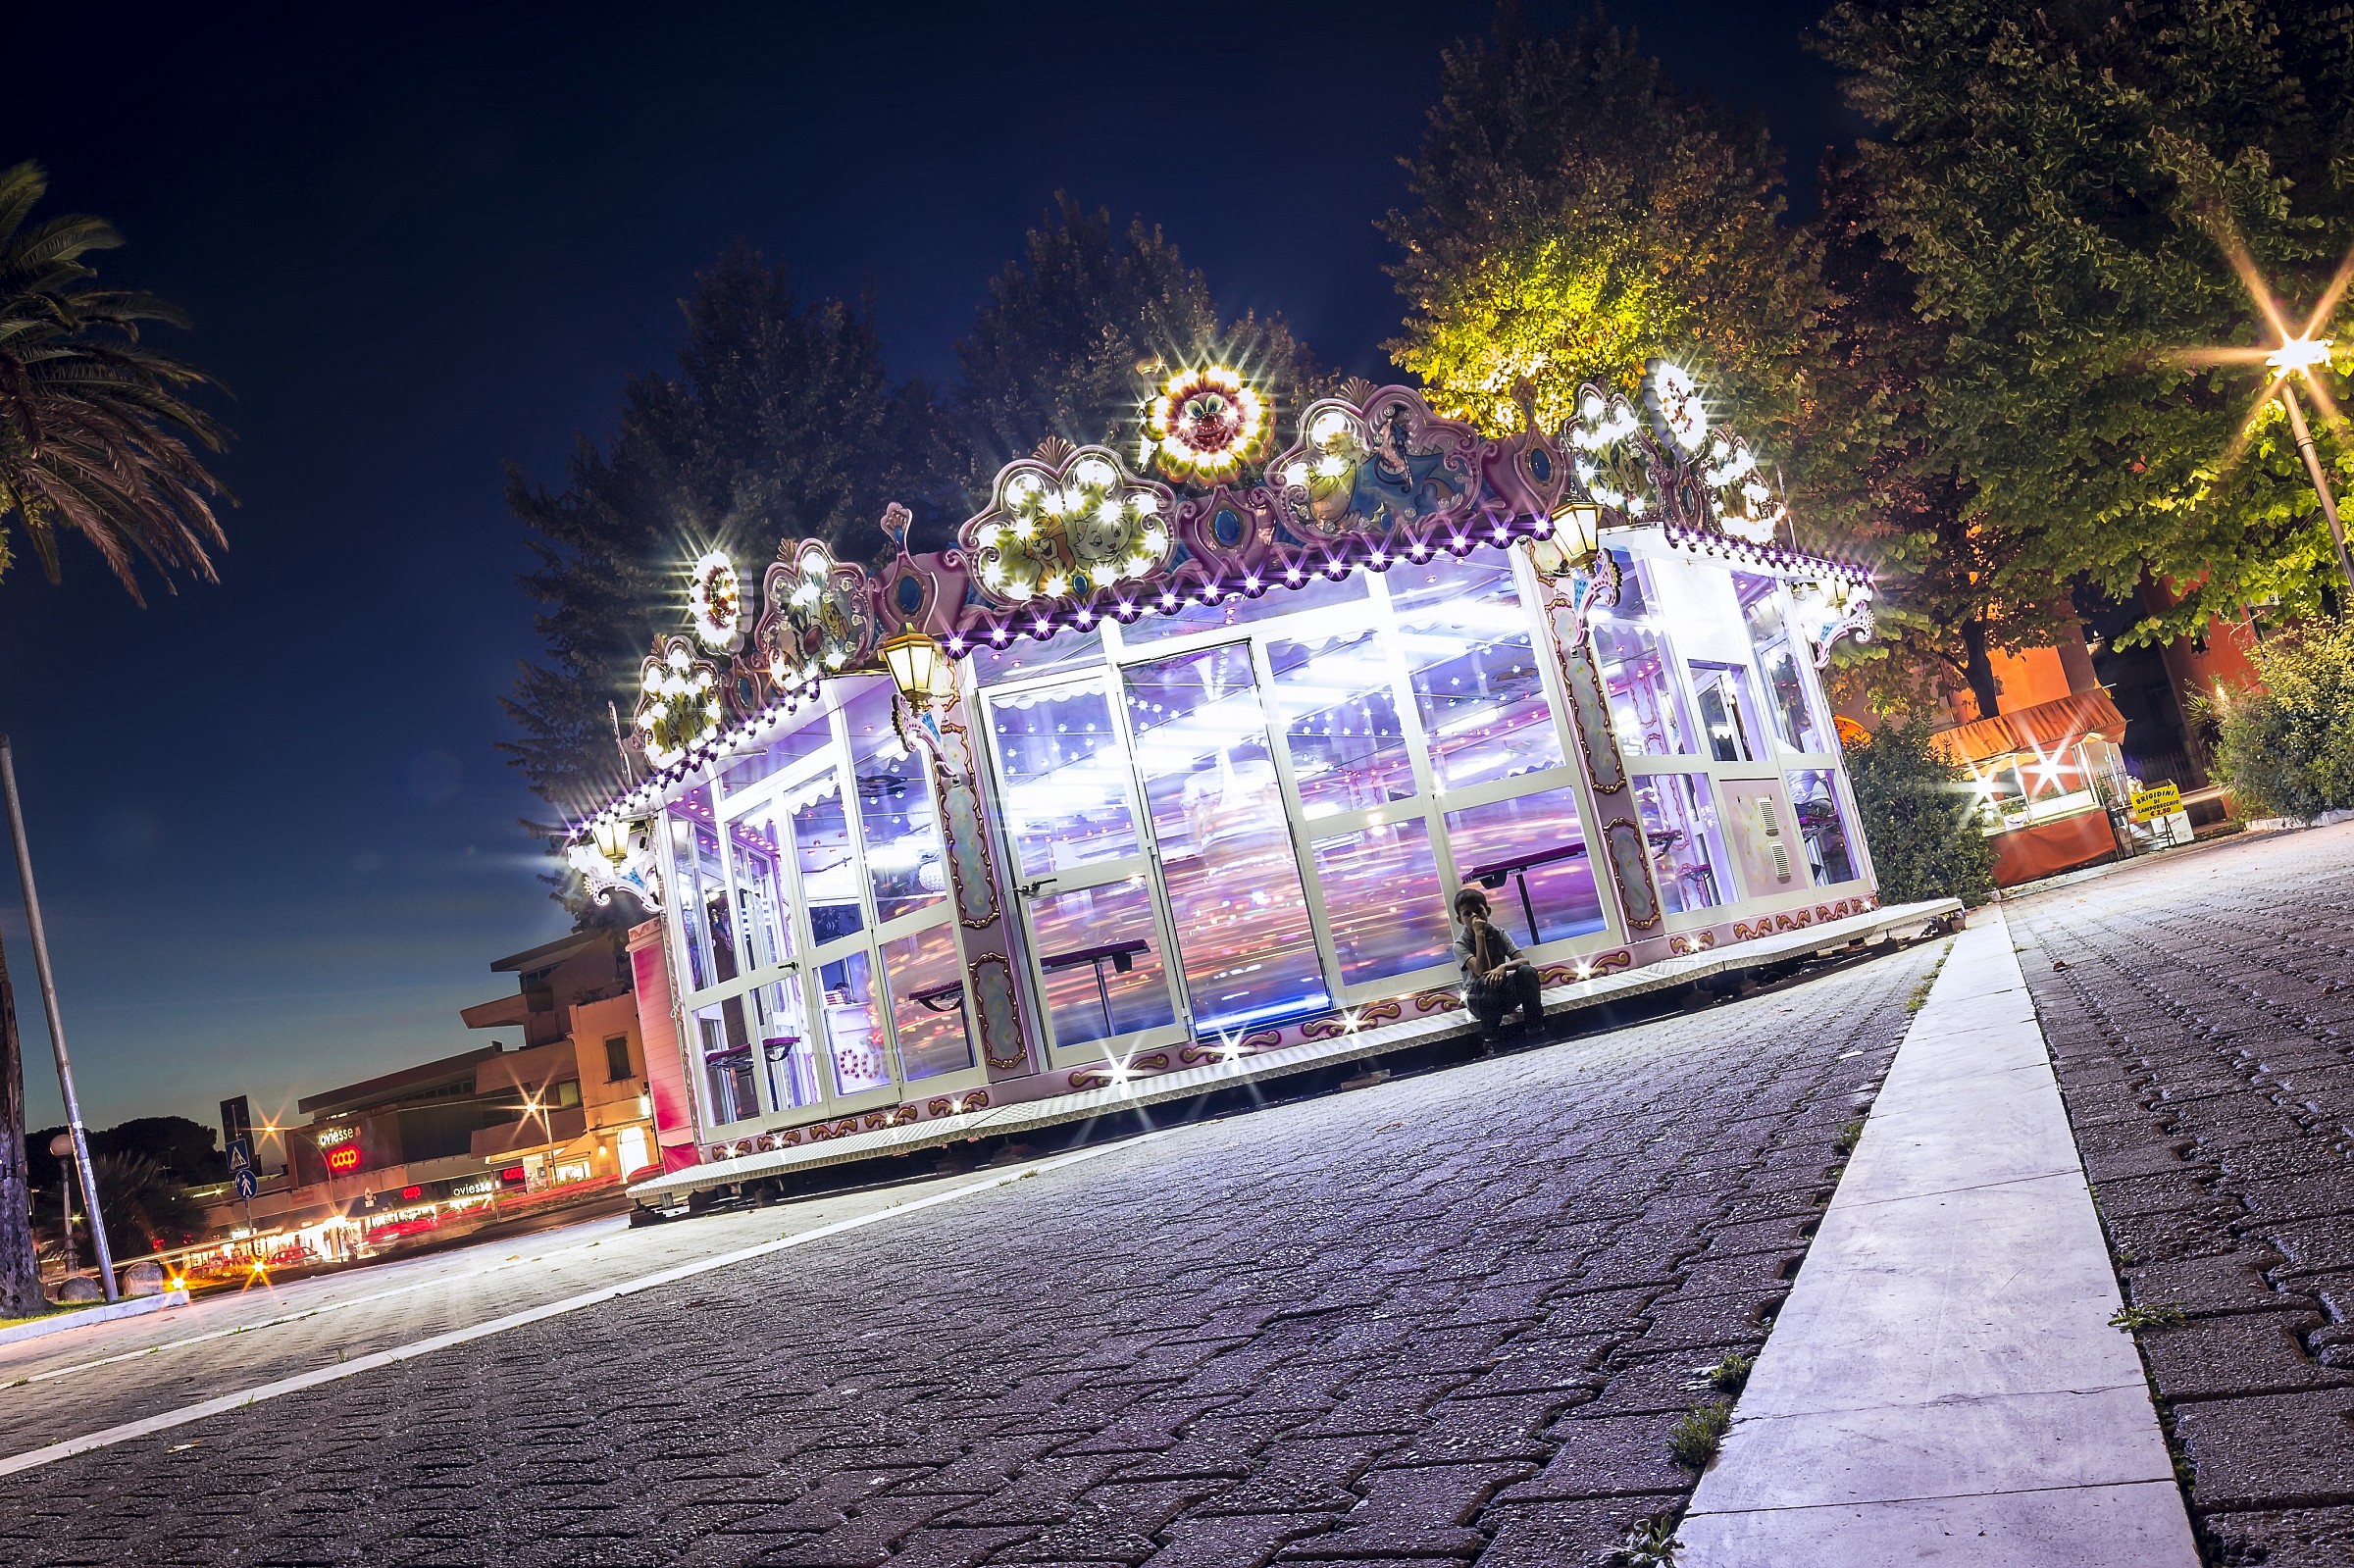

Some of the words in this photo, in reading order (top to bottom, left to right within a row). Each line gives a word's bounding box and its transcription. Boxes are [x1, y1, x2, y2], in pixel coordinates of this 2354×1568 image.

[2135, 789, 2175, 805] BRIGIDINI
[2137, 799, 2179, 814] LAMPORECCHIO
[320, 1128, 354, 1146] oviesse
[332, 1149, 357, 1169] coop
[453, 1181, 492, 1196] oviesse
